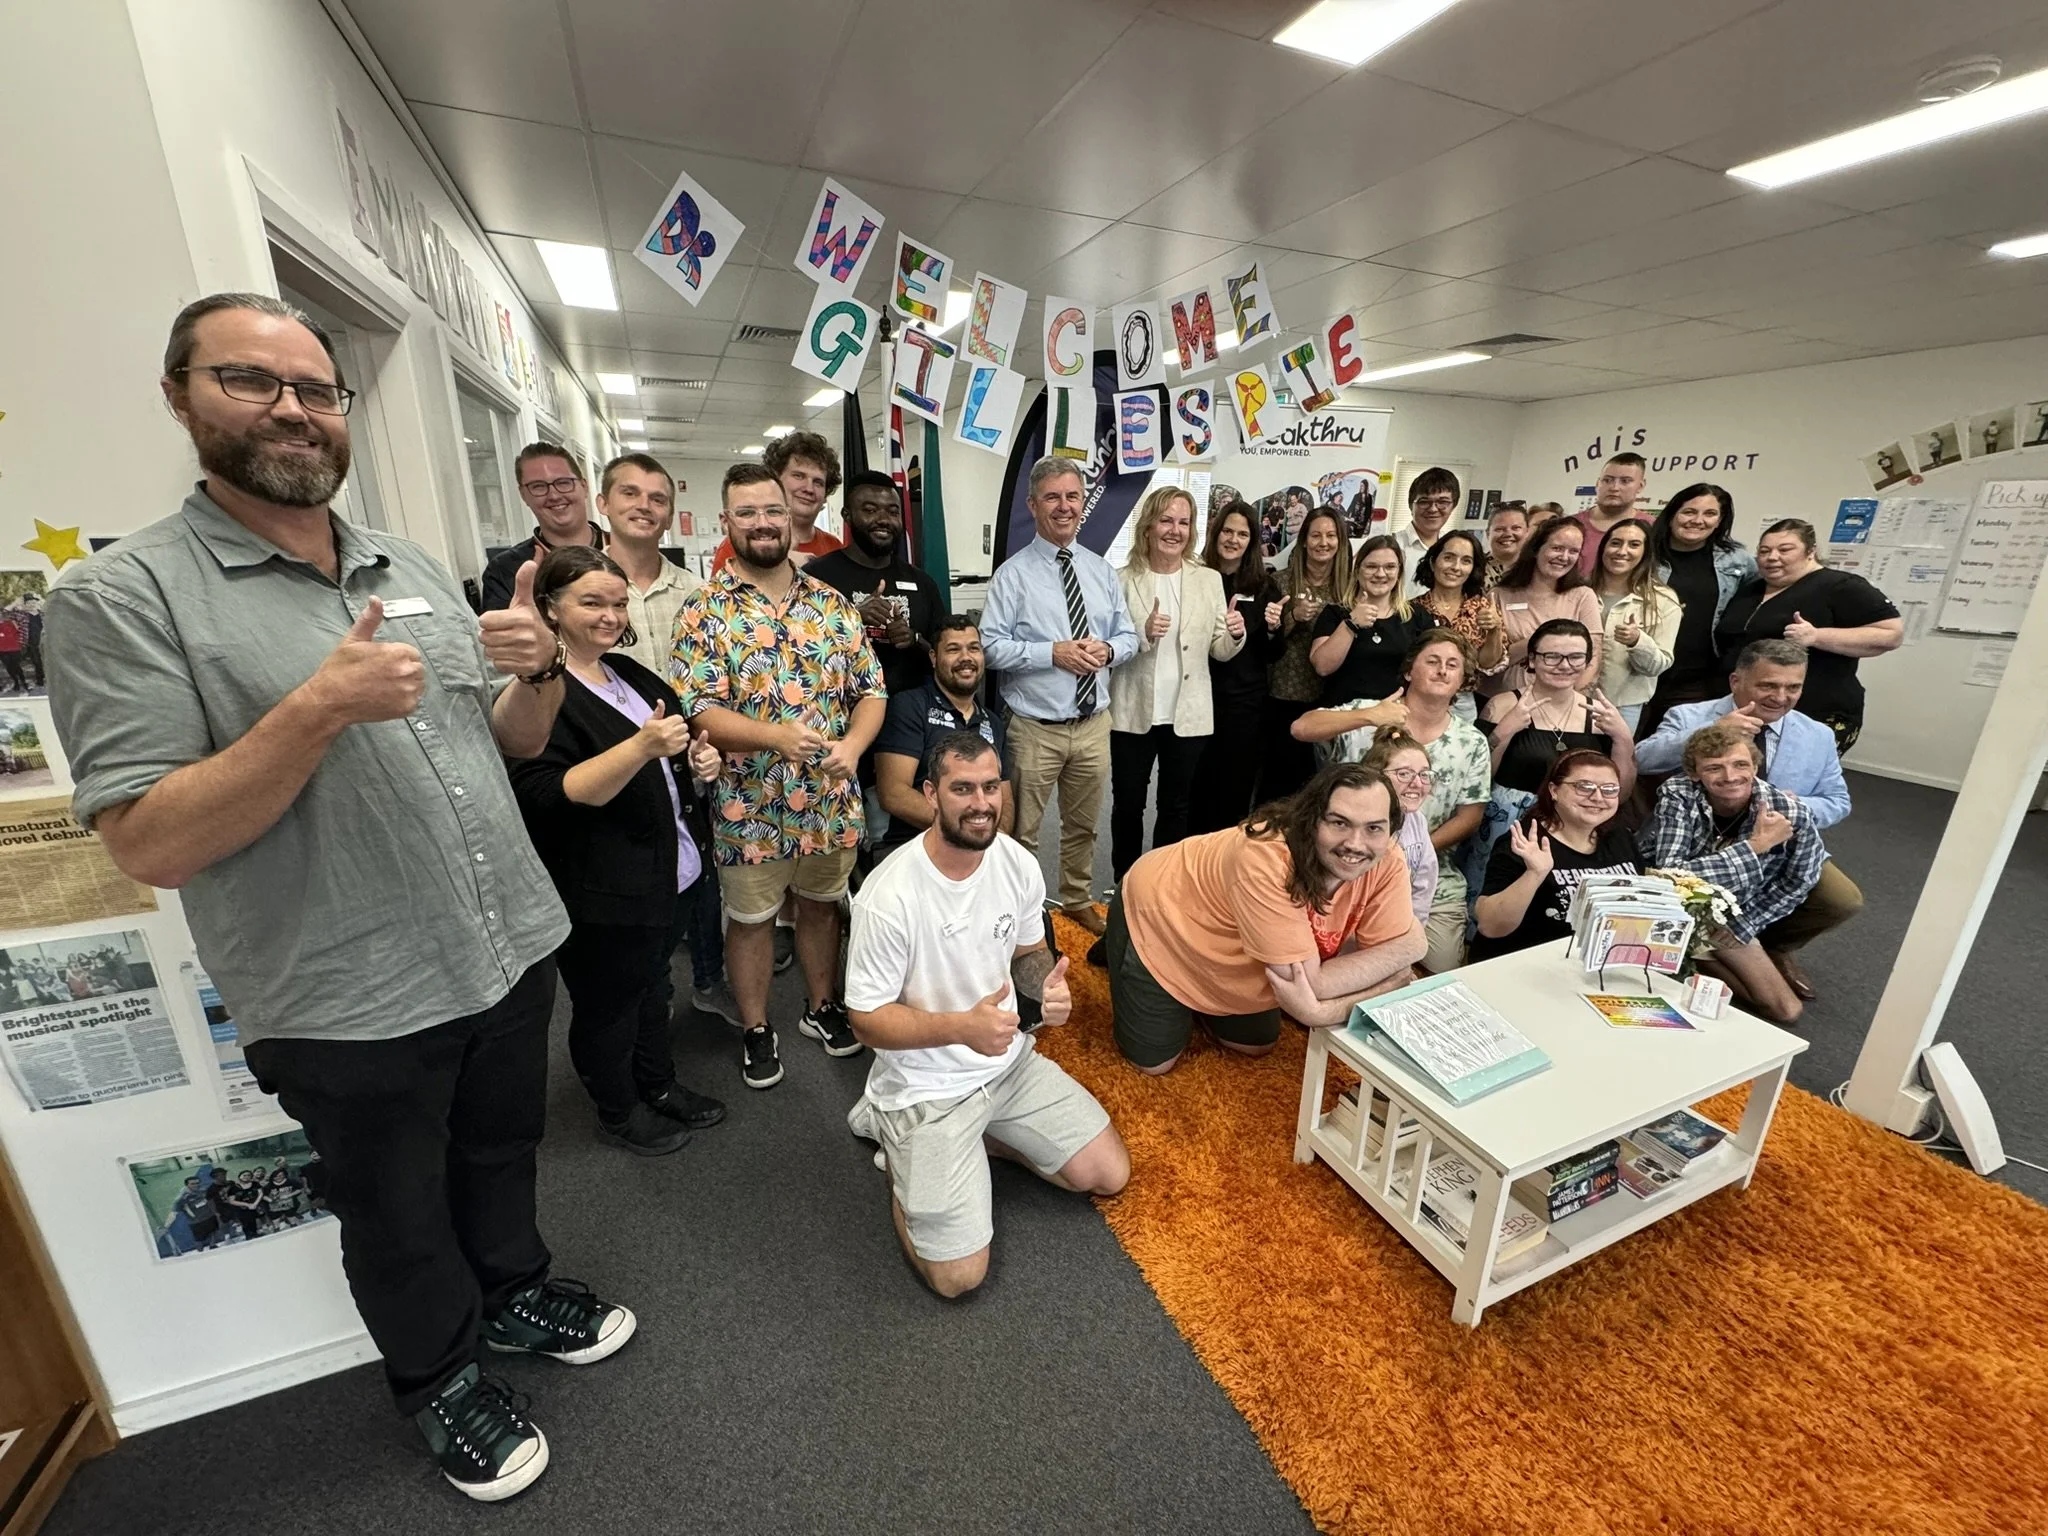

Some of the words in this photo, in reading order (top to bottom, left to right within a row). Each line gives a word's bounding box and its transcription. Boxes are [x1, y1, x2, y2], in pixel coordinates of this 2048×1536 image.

[646, 190, 717, 291] DR
[808, 188, 1271, 380] WELCOME
[809, 300, 1365, 467] GILLESPIE
[1240, 416, 1365, 447] akthru
[1240, 447, 1258, 457] YOU,
[1260, 448, 1311, 457] EMPOWERED.
[1564, 426, 1647, 473] ndis
[1643, 453, 1759, 472] UPPORT
[1988, 484, 2026, 505] Pick
[1075, 484, 1106, 535] POWERED.
[41, 829, 93, 843] debut
[2, 1005, 99, 1031] Brightstars
[103, 1000, 119, 1012] in
[122, 996, 150, 1009] the
[7, 1020, 75, 1042] musical
[79, 1007, 152, 1030] spotlight
[78, 1091, 90, 1101] to
[151, 1075, 162, 1085] in
[1430, 1169, 1476, 1195] KING
[1557, 1184, 1576, 1199] JAMES
[1552, 1191, 1585, 1208] PATTERSON
[1499, 1213, 1537, 1238] EEDS
